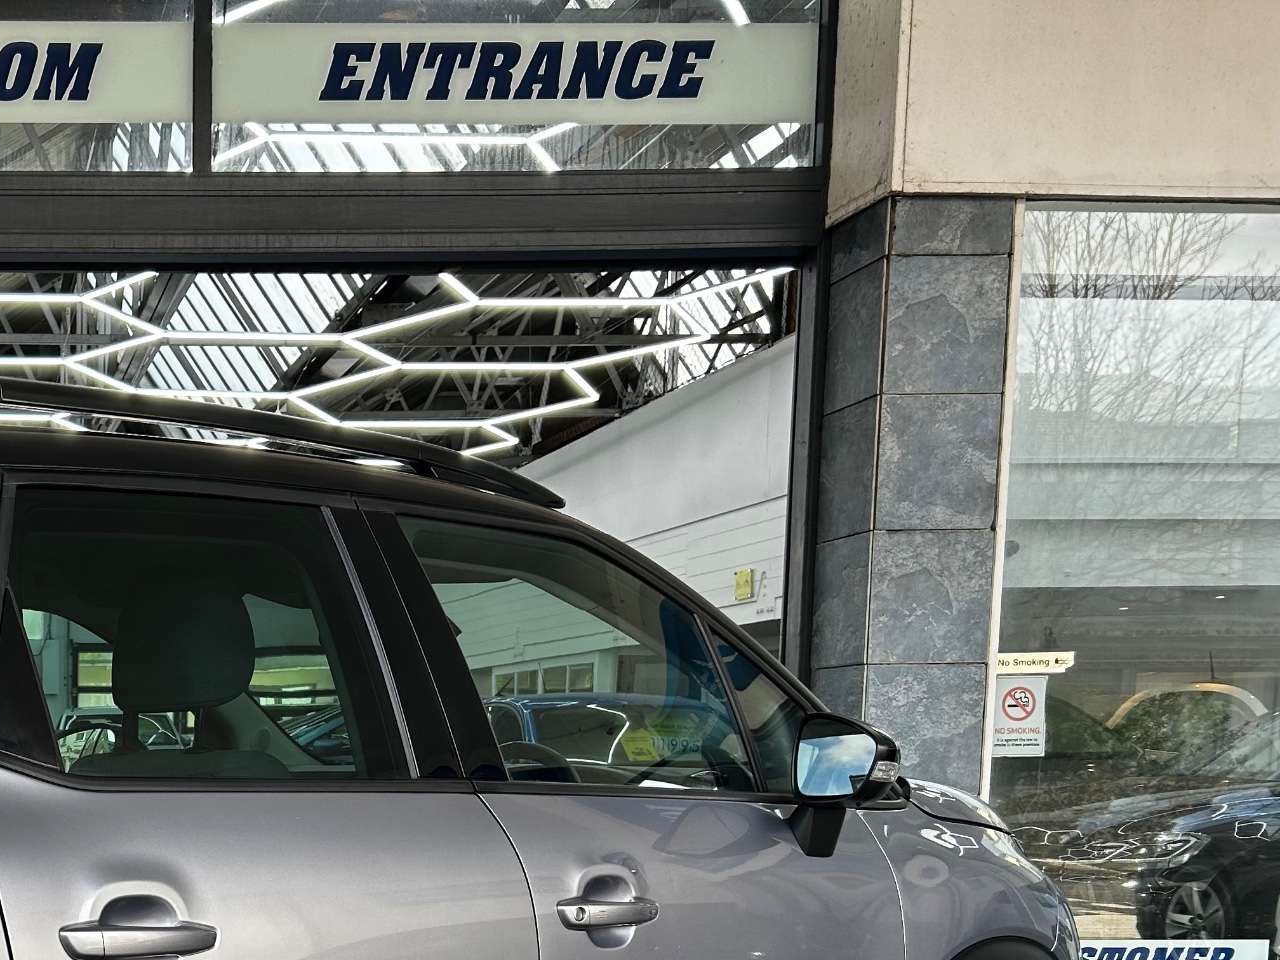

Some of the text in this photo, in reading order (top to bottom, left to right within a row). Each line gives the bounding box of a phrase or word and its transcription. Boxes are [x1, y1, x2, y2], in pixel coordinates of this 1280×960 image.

[319, 39, 716, 101] ENTRANCE
[997, 658, 1050, 667] No Smoking
[994, 727, 1006, 735] NO
